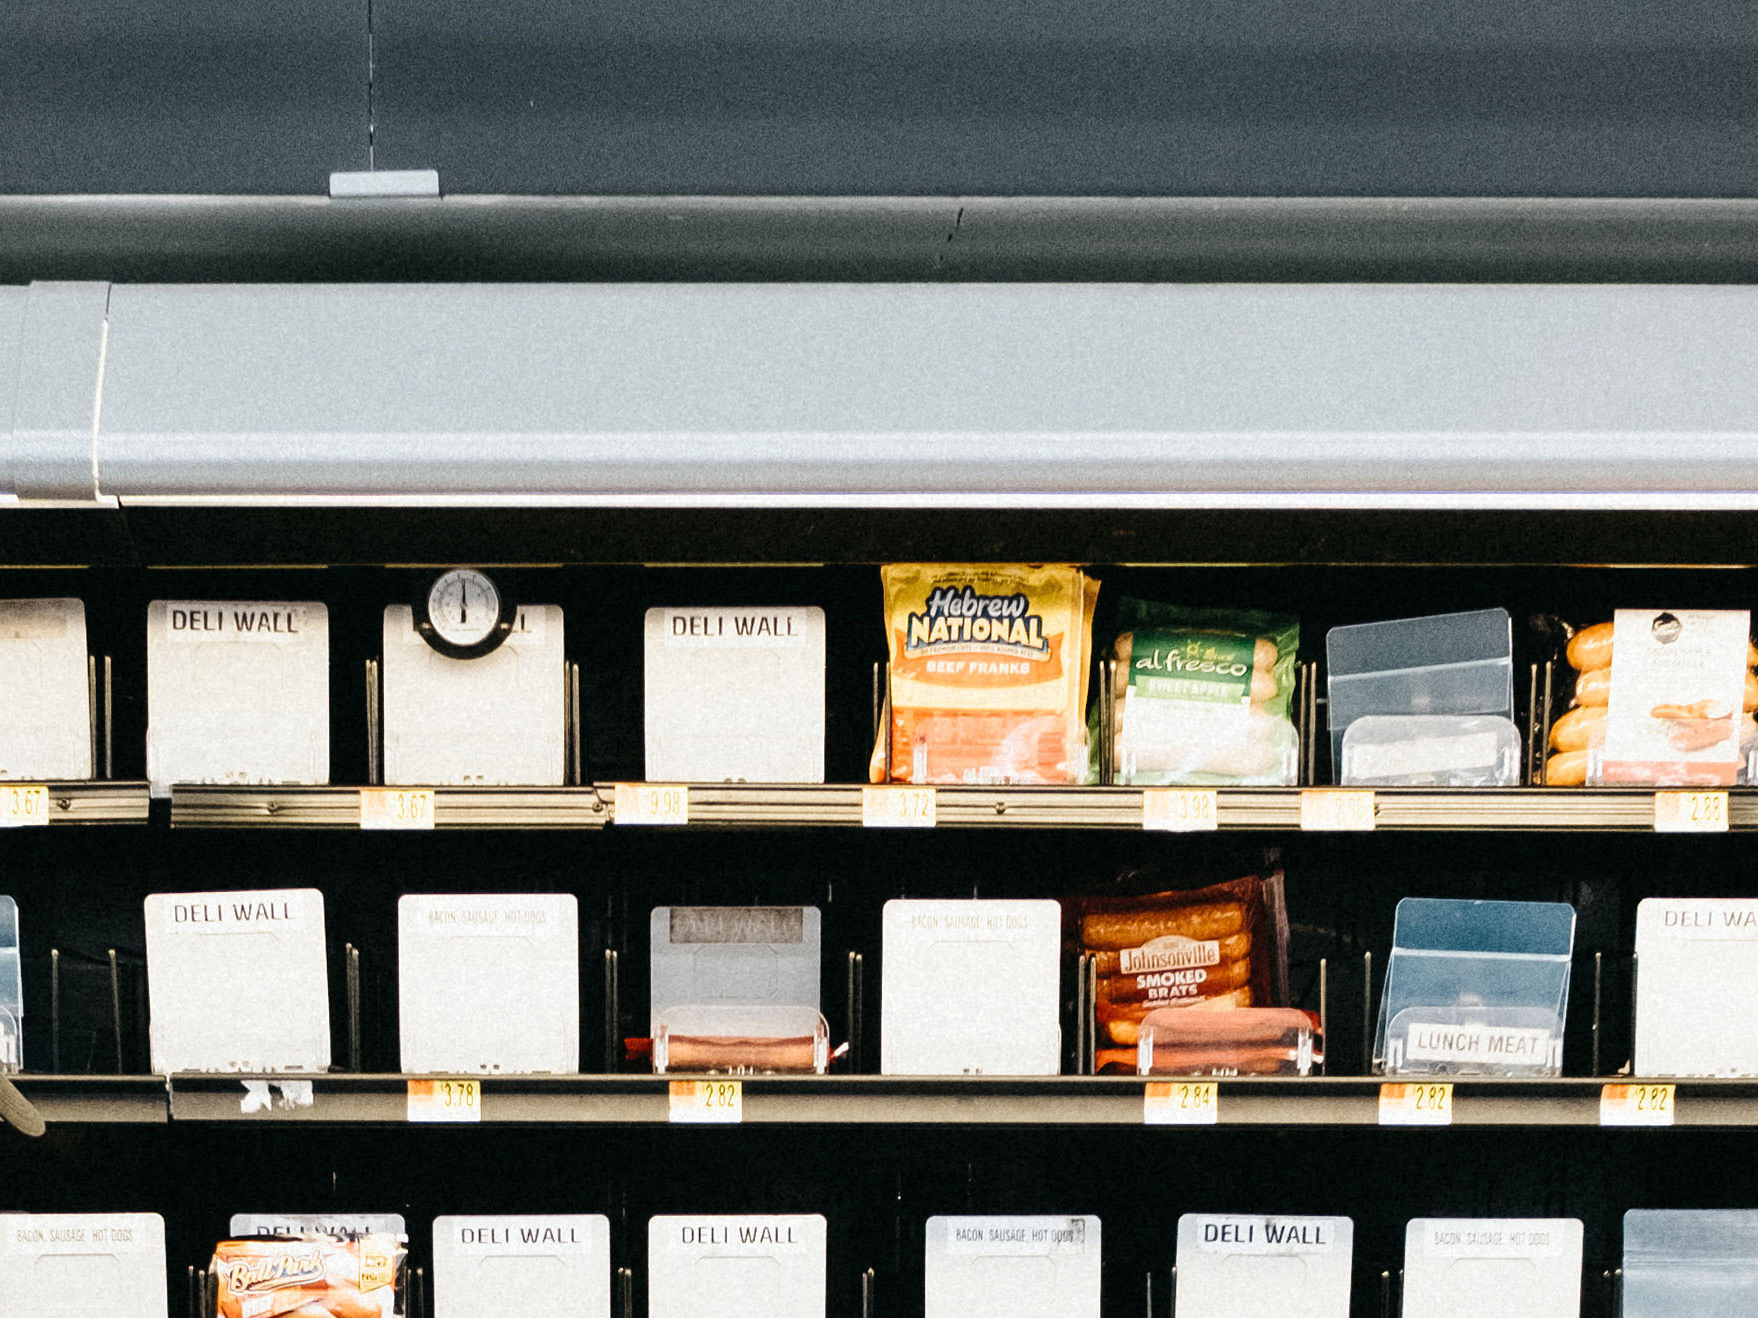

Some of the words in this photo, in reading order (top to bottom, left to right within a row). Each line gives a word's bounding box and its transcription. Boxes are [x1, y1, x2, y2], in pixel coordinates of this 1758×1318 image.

[929, 589, 1026, 617] Hebrew
[172, 609, 224, 632] DELI
[233, 611, 299, 634] WALL
[672, 615, 724, 636] DELI
[733, 616, 797, 637] WALL
[910, 616, 1045, 648] NATIONAL
[927, 660, 965, 673] BEEF
[970, 661, 1030, 674] FRANKS
[1166, 648, 1247, 677] fresco
[173, 904, 223, 923] DELI
[232, 902, 295, 922] WALL
[1124, 943, 1216, 970] Johnsonville
[1136, 968, 1207, 990] SMOKED
[1148, 984, 1197, 998] BRATS
[1417, 1036, 1479, 1053] LUNCH
[1488, 1038, 1537, 1056] MEAT
[460, 1227, 510, 1244] DELI
[519, 1227, 582, 1244] WALL
[681, 1226, 728, 1245] DELI
[738, 1226, 798, 1244] WALL
[1203, 1223, 1254, 1243] DELI
[1264, 1220, 1329, 1245] WALL
[230, 1261, 274, 1291] Ball
[275, 1249, 323, 1277] Park
